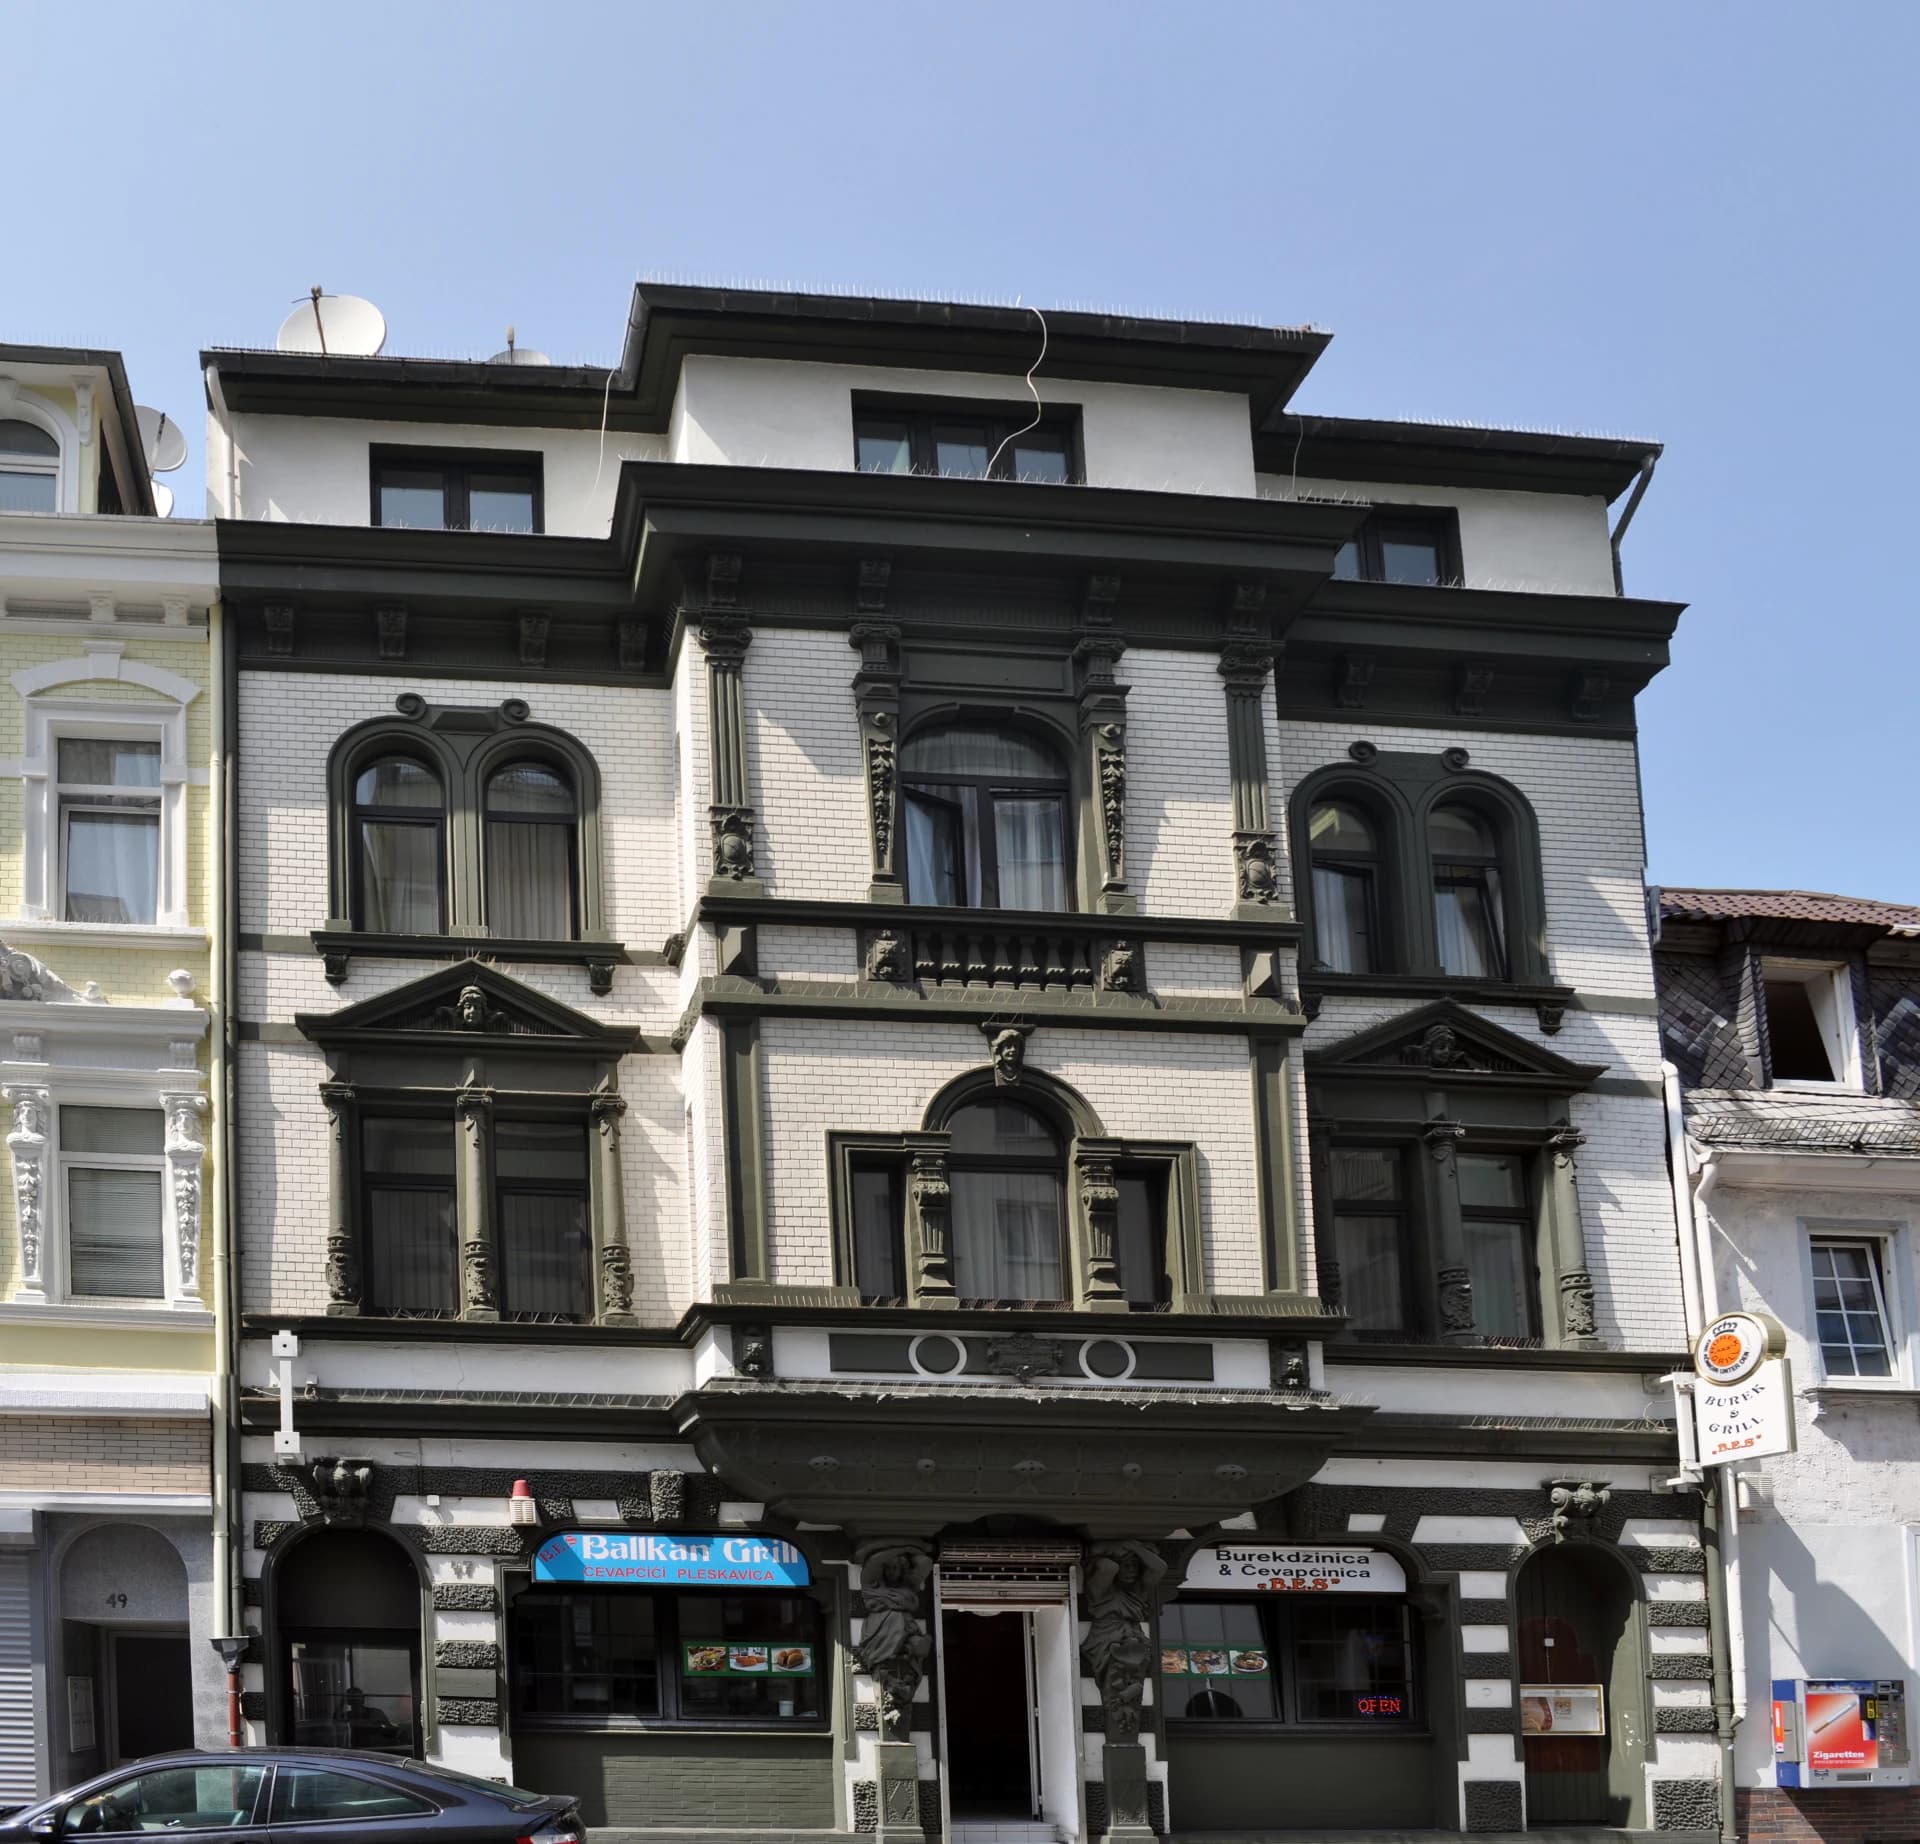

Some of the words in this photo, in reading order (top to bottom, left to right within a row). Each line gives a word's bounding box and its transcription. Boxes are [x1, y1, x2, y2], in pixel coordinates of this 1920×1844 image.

[1705, 1383, 1766, 1407] BUREK
[1729, 1410, 1740, 1419] &
[1708, 1417, 1764, 1434] GRILL
[582, 1535, 710, 1562] Ballkan
[723, 1538, 798, 1564] Grill
[1219, 1564, 1232, 1576] &
[105, 1593, 128, 1609] 49
[1358, 1699, 1401, 1713] OPEN
[1812, 1751, 1865, 1760] Zigaretten
